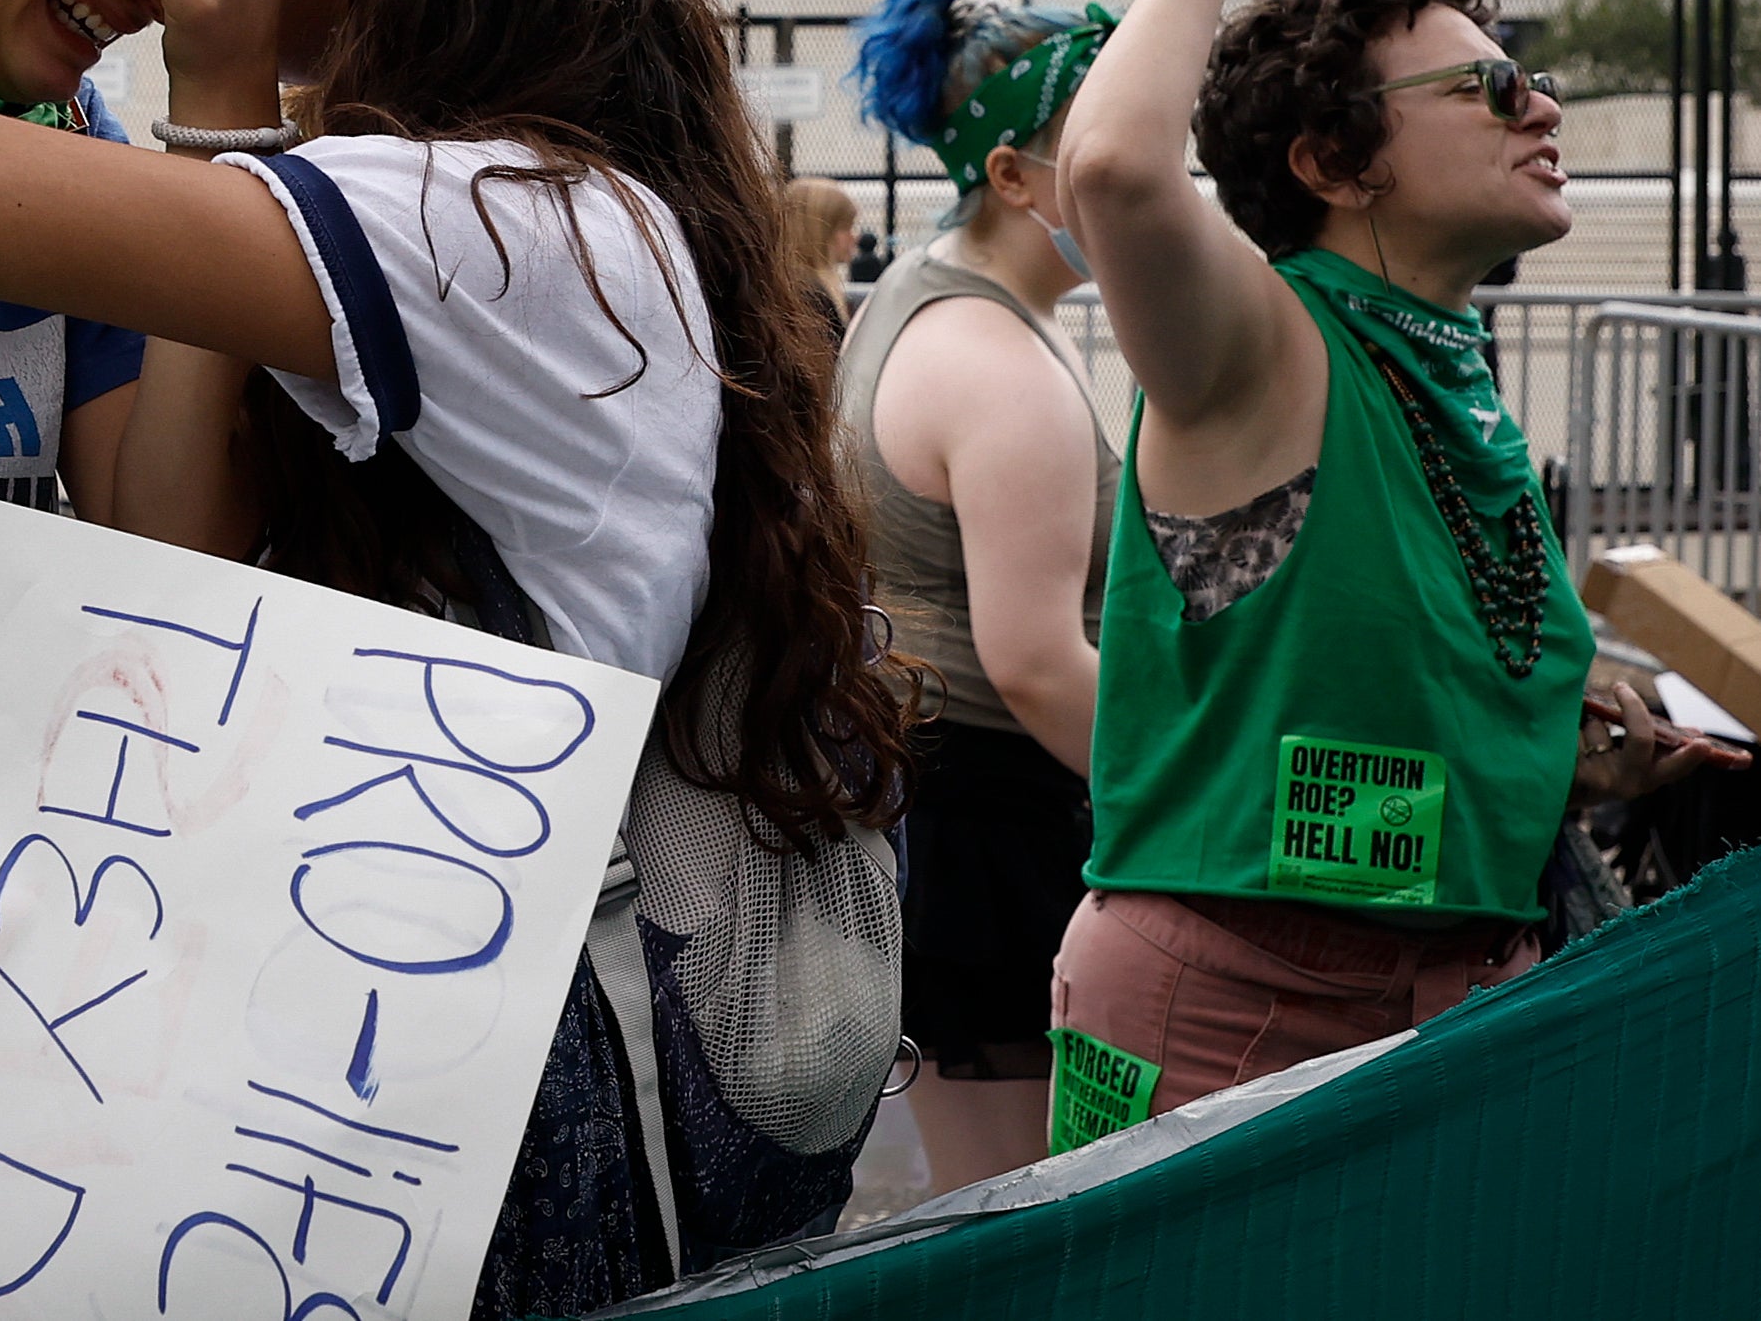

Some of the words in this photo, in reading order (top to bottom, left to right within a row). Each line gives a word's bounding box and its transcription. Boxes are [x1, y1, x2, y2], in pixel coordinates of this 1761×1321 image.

[1291, 745, 1426, 791] OVERTURN
[1287, 780, 1356, 818] ROE?
[1283, 818, 1358, 865] HELL
[1369, 829, 1425, 873] NO!
[1061, 1030, 1142, 1099] FORCED
[1069, 1101, 1127, 1139] FEMAL
